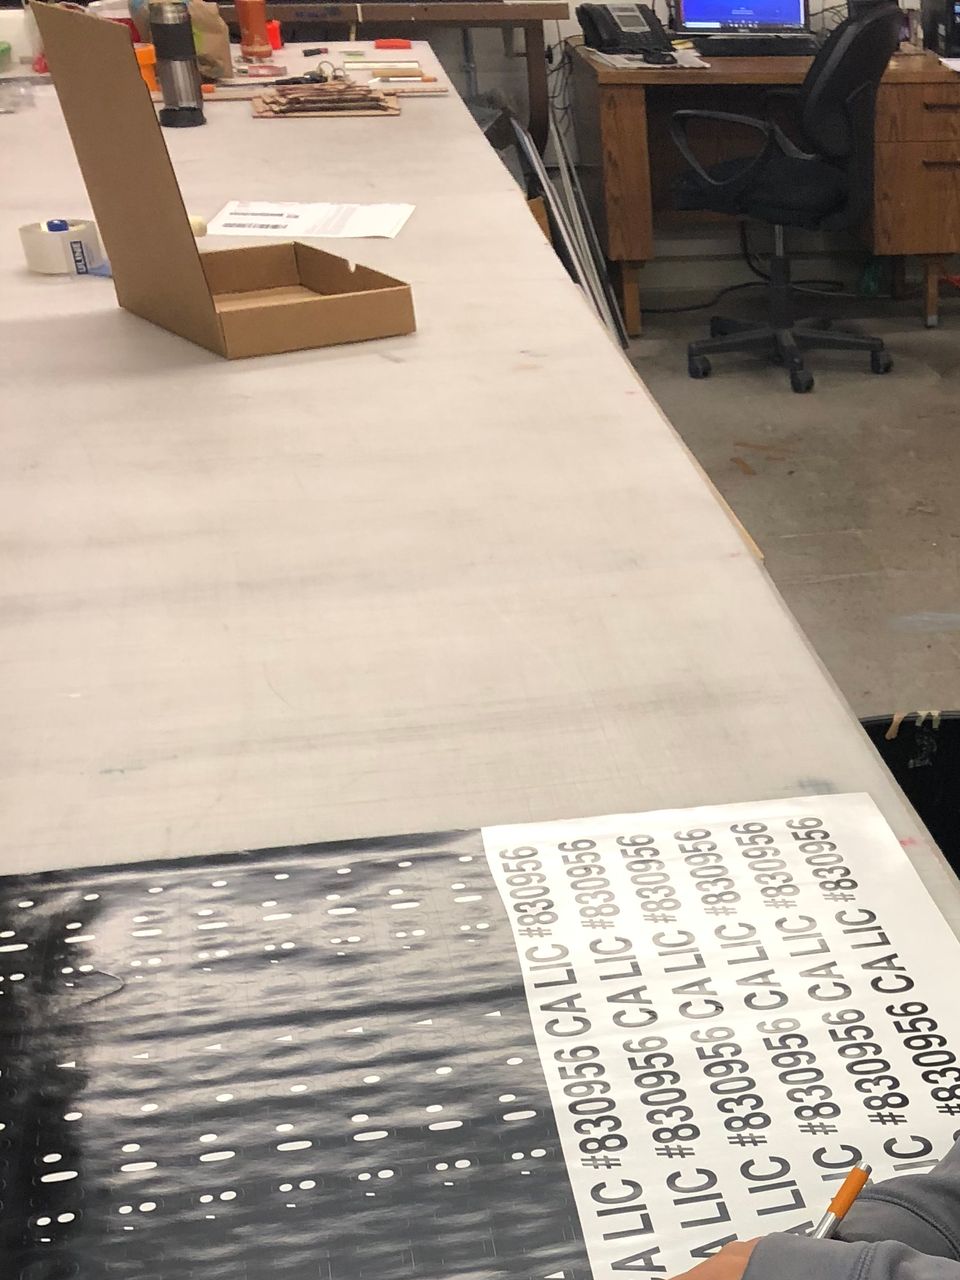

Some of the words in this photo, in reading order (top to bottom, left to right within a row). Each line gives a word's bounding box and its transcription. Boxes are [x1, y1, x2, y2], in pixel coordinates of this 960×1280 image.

[558, 838, 619, 930] #830956
[616, 834, 682, 924] #830956
[673, 828, 741, 915] #830956
[729, 822, 801, 908] #830956
[786, 817, 858, 902] #830956
[500, 846, 557, 939] #830956
[589, 936, 642, 979] LIC
[652, 929, 706, 973] LIC
[715, 922, 769, 965] LIC
[774, 915, 830, 957] LIC
[834, 908, 891, 950] LIC
[525, 942, 580, 990] LIC
[736, 968, 788, 1010] CA
[799, 961, 852, 1002] CA
[861, 953, 914, 994] CA
[540, 993, 591, 1037] CA
[606, 985, 658, 1028] CA
[672, 977, 724, 1019] CA
[622, 1036, 701, 1159] #830956
[690, 1026, 772, 1148] #830956
[760, 1017, 842, 1135] #830956
[822, 1008, 909, 1126] #830956
[554, 1045, 628, 1170] #830956
[591, 1178, 656, 1242] LIC
[666, 1167, 731, 1229] LIC
[740, 1155, 806, 1216] LIC
